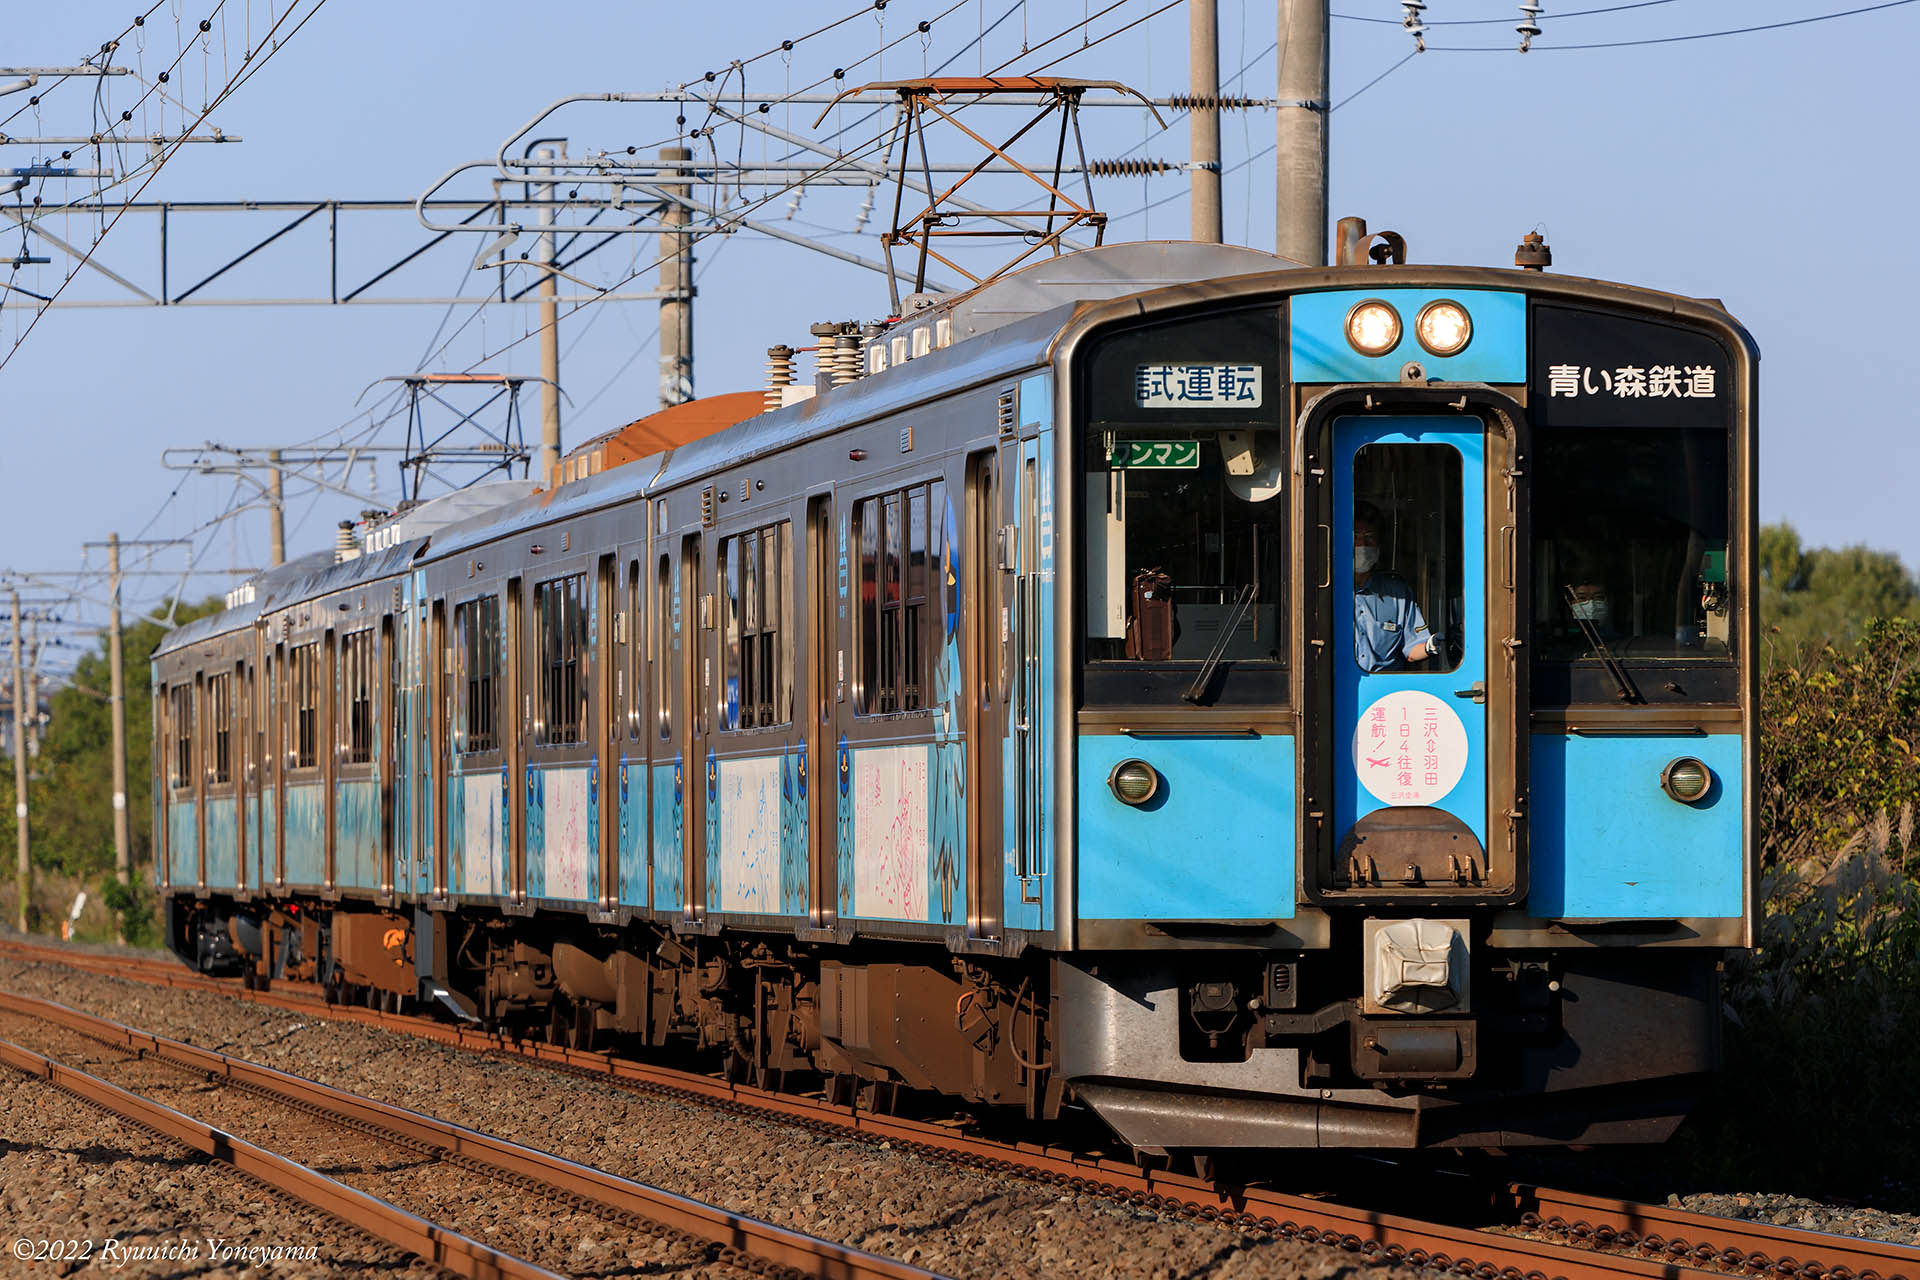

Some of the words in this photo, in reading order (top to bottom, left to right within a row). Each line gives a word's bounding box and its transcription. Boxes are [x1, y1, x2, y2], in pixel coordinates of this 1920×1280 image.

[1136, 366, 1255, 401] 試運転
[1548, 364, 1716, 398] 青い森鉄道
[1111, 443, 1196, 465] ワンマン
[1397, 707, 1413, 786] 1日4往復
